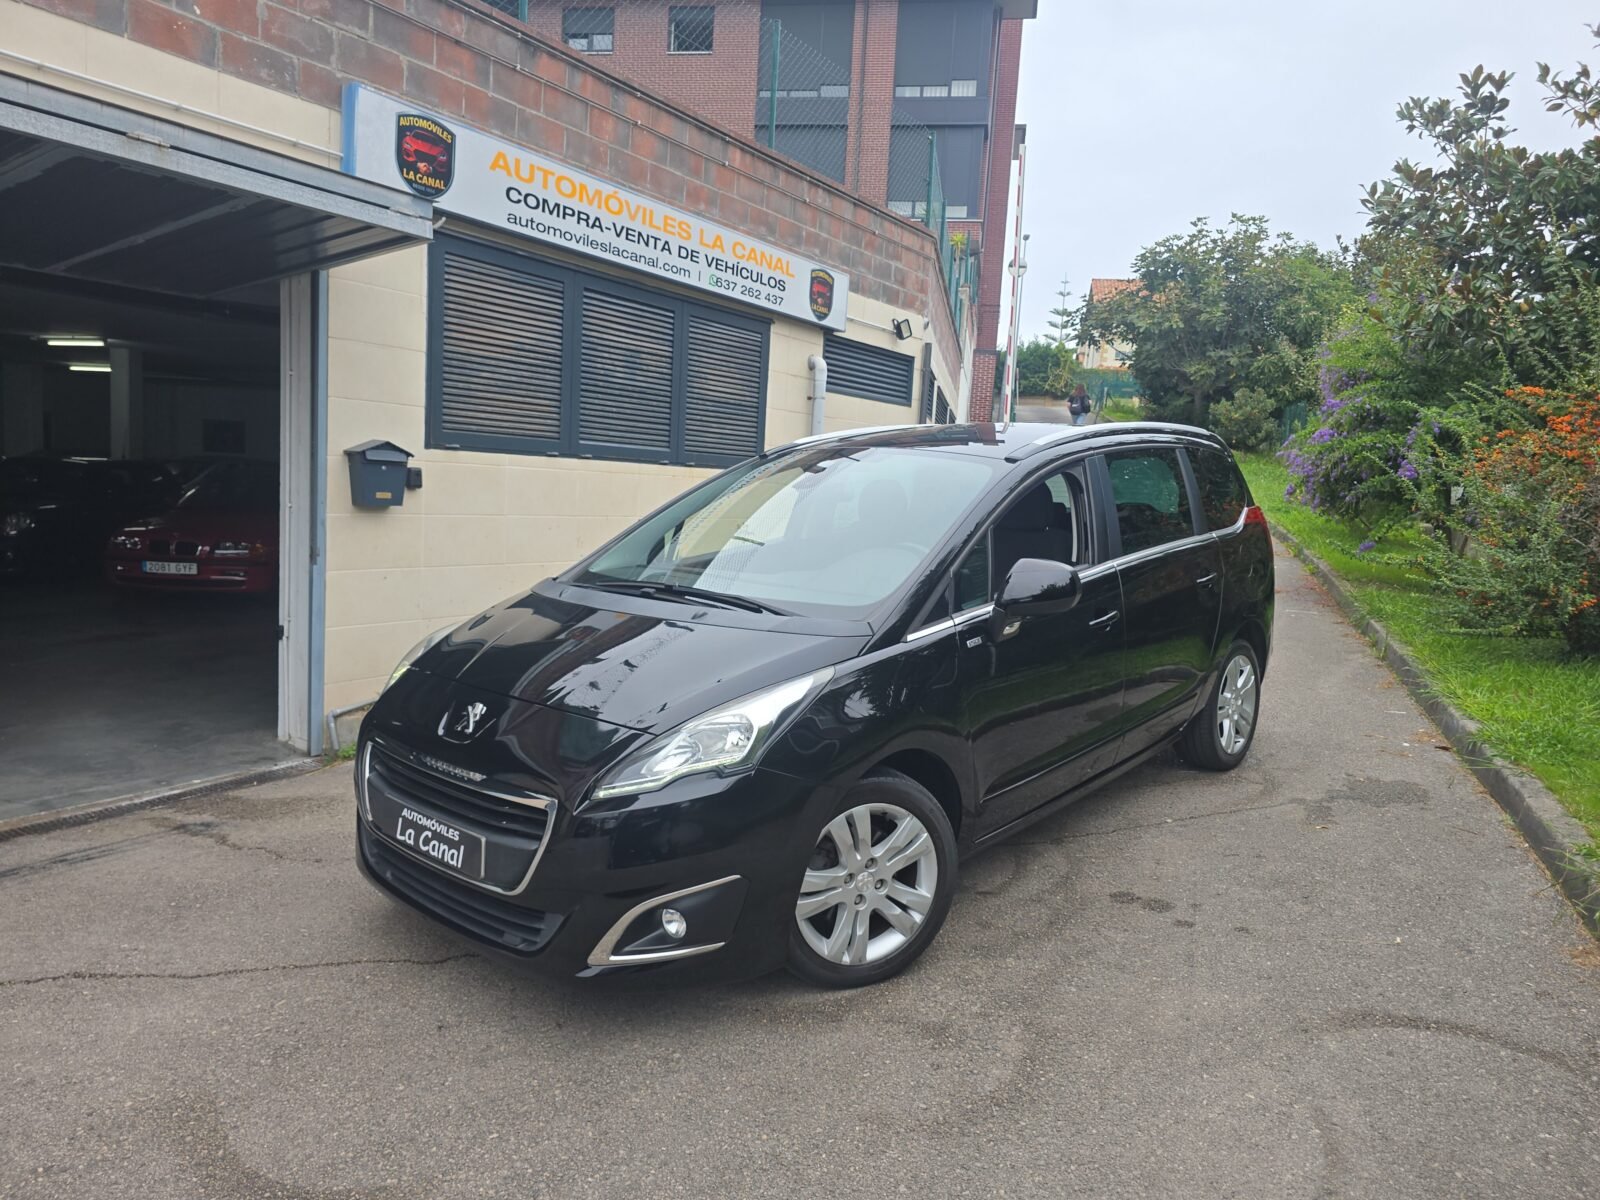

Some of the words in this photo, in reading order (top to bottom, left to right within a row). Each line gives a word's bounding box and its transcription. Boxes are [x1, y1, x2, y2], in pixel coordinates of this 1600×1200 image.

[400, 116, 452, 144] AUTOMÓVILES
[403, 168, 415, 181] LA
[416, 174, 445, 190] CANAL
[489, 151, 692, 241] AUTOMÓVILES
[699, 228, 725, 253] LA
[732, 239, 796, 279] CANAL
[505, 186, 672, 255] COMPRA-VENTA
[678, 245, 700, 264] DE
[705, 254, 787, 292] VEHÍCULOS
[506, 211, 691, 279] automovileslacanal.com
[716, 278, 737, 292] 637
[741, 285, 761, 299] 262
[765, 292, 784, 306] 437
[148, 562, 171, 572] 2081
[396, 817, 414, 846] La
[419, 832, 465, 869] Canal
[401, 807, 460, 841] AUTOMÓVILES
